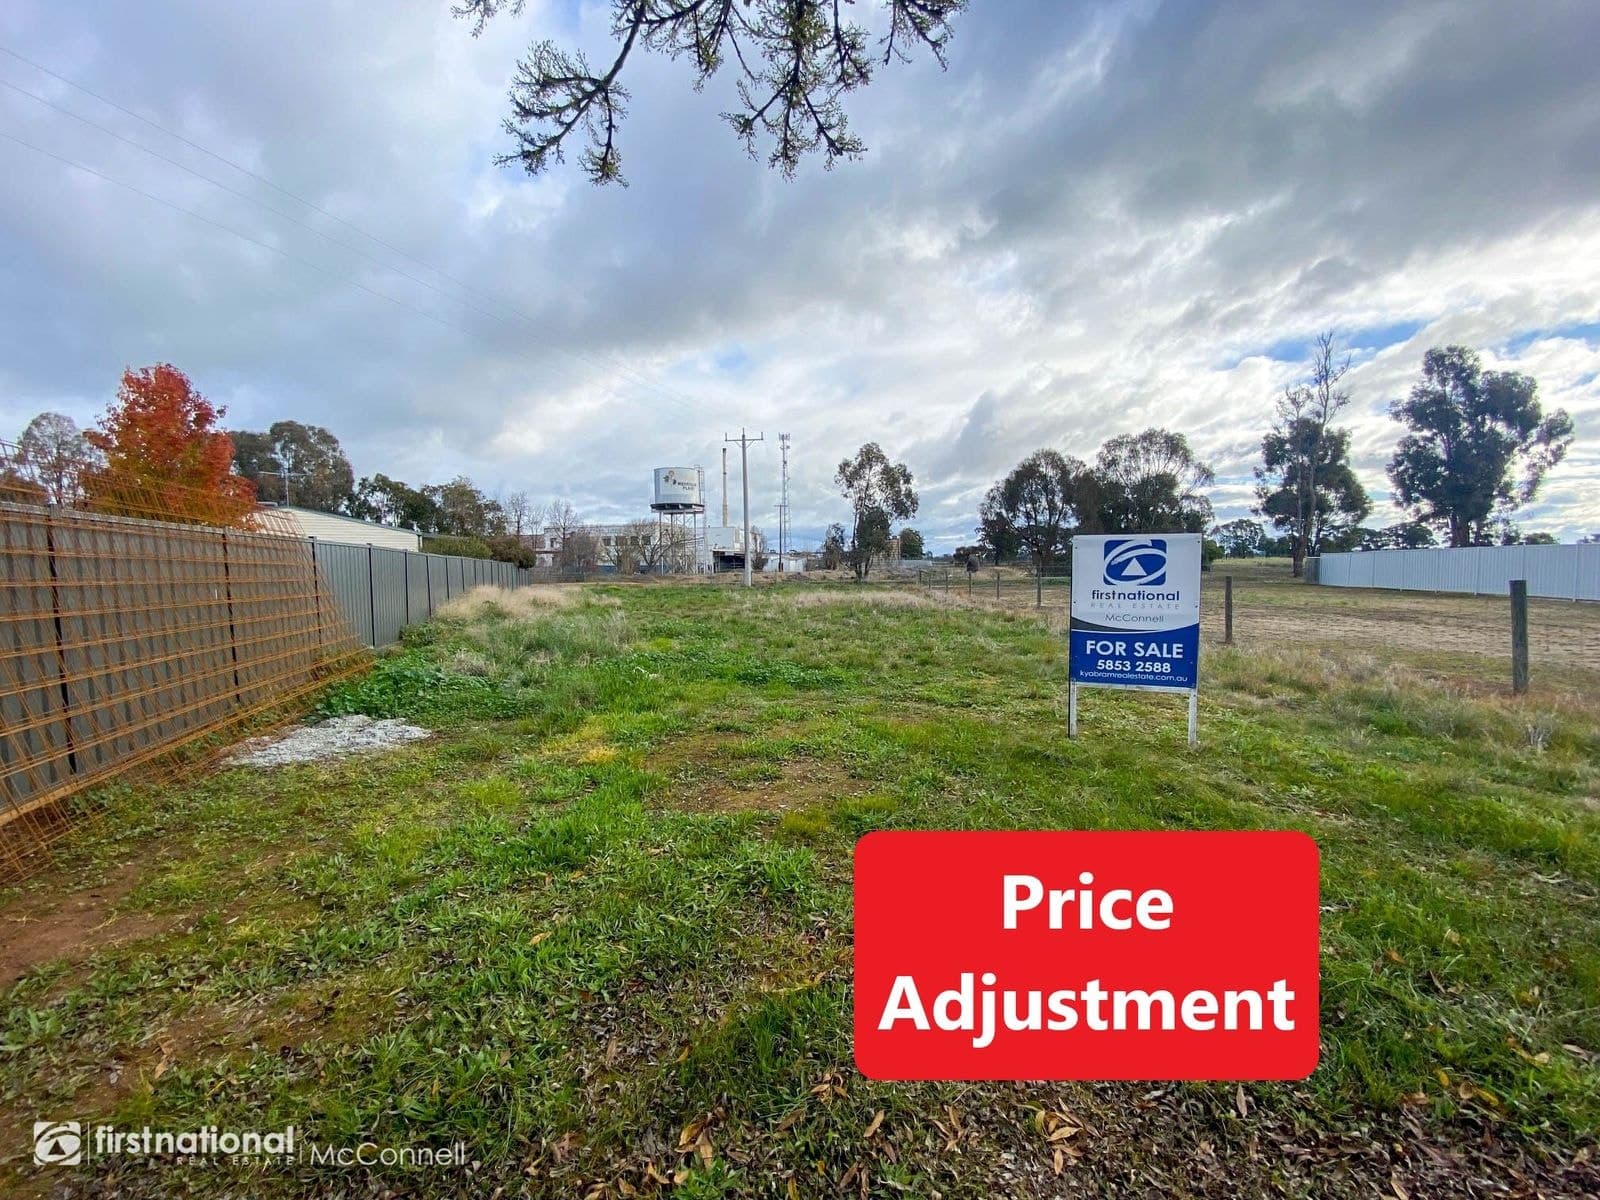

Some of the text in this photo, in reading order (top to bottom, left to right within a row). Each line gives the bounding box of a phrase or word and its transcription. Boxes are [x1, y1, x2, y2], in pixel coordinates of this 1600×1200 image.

[1091, 590, 1180, 601] firstnational
[1105, 613, 1164, 623] McConnell
[1086, 640, 1184, 658] FOR SALE
[1096, 660, 1171, 673] 5853 2588
[1079, 670, 1188, 682] kyabramrealestate.com.au
